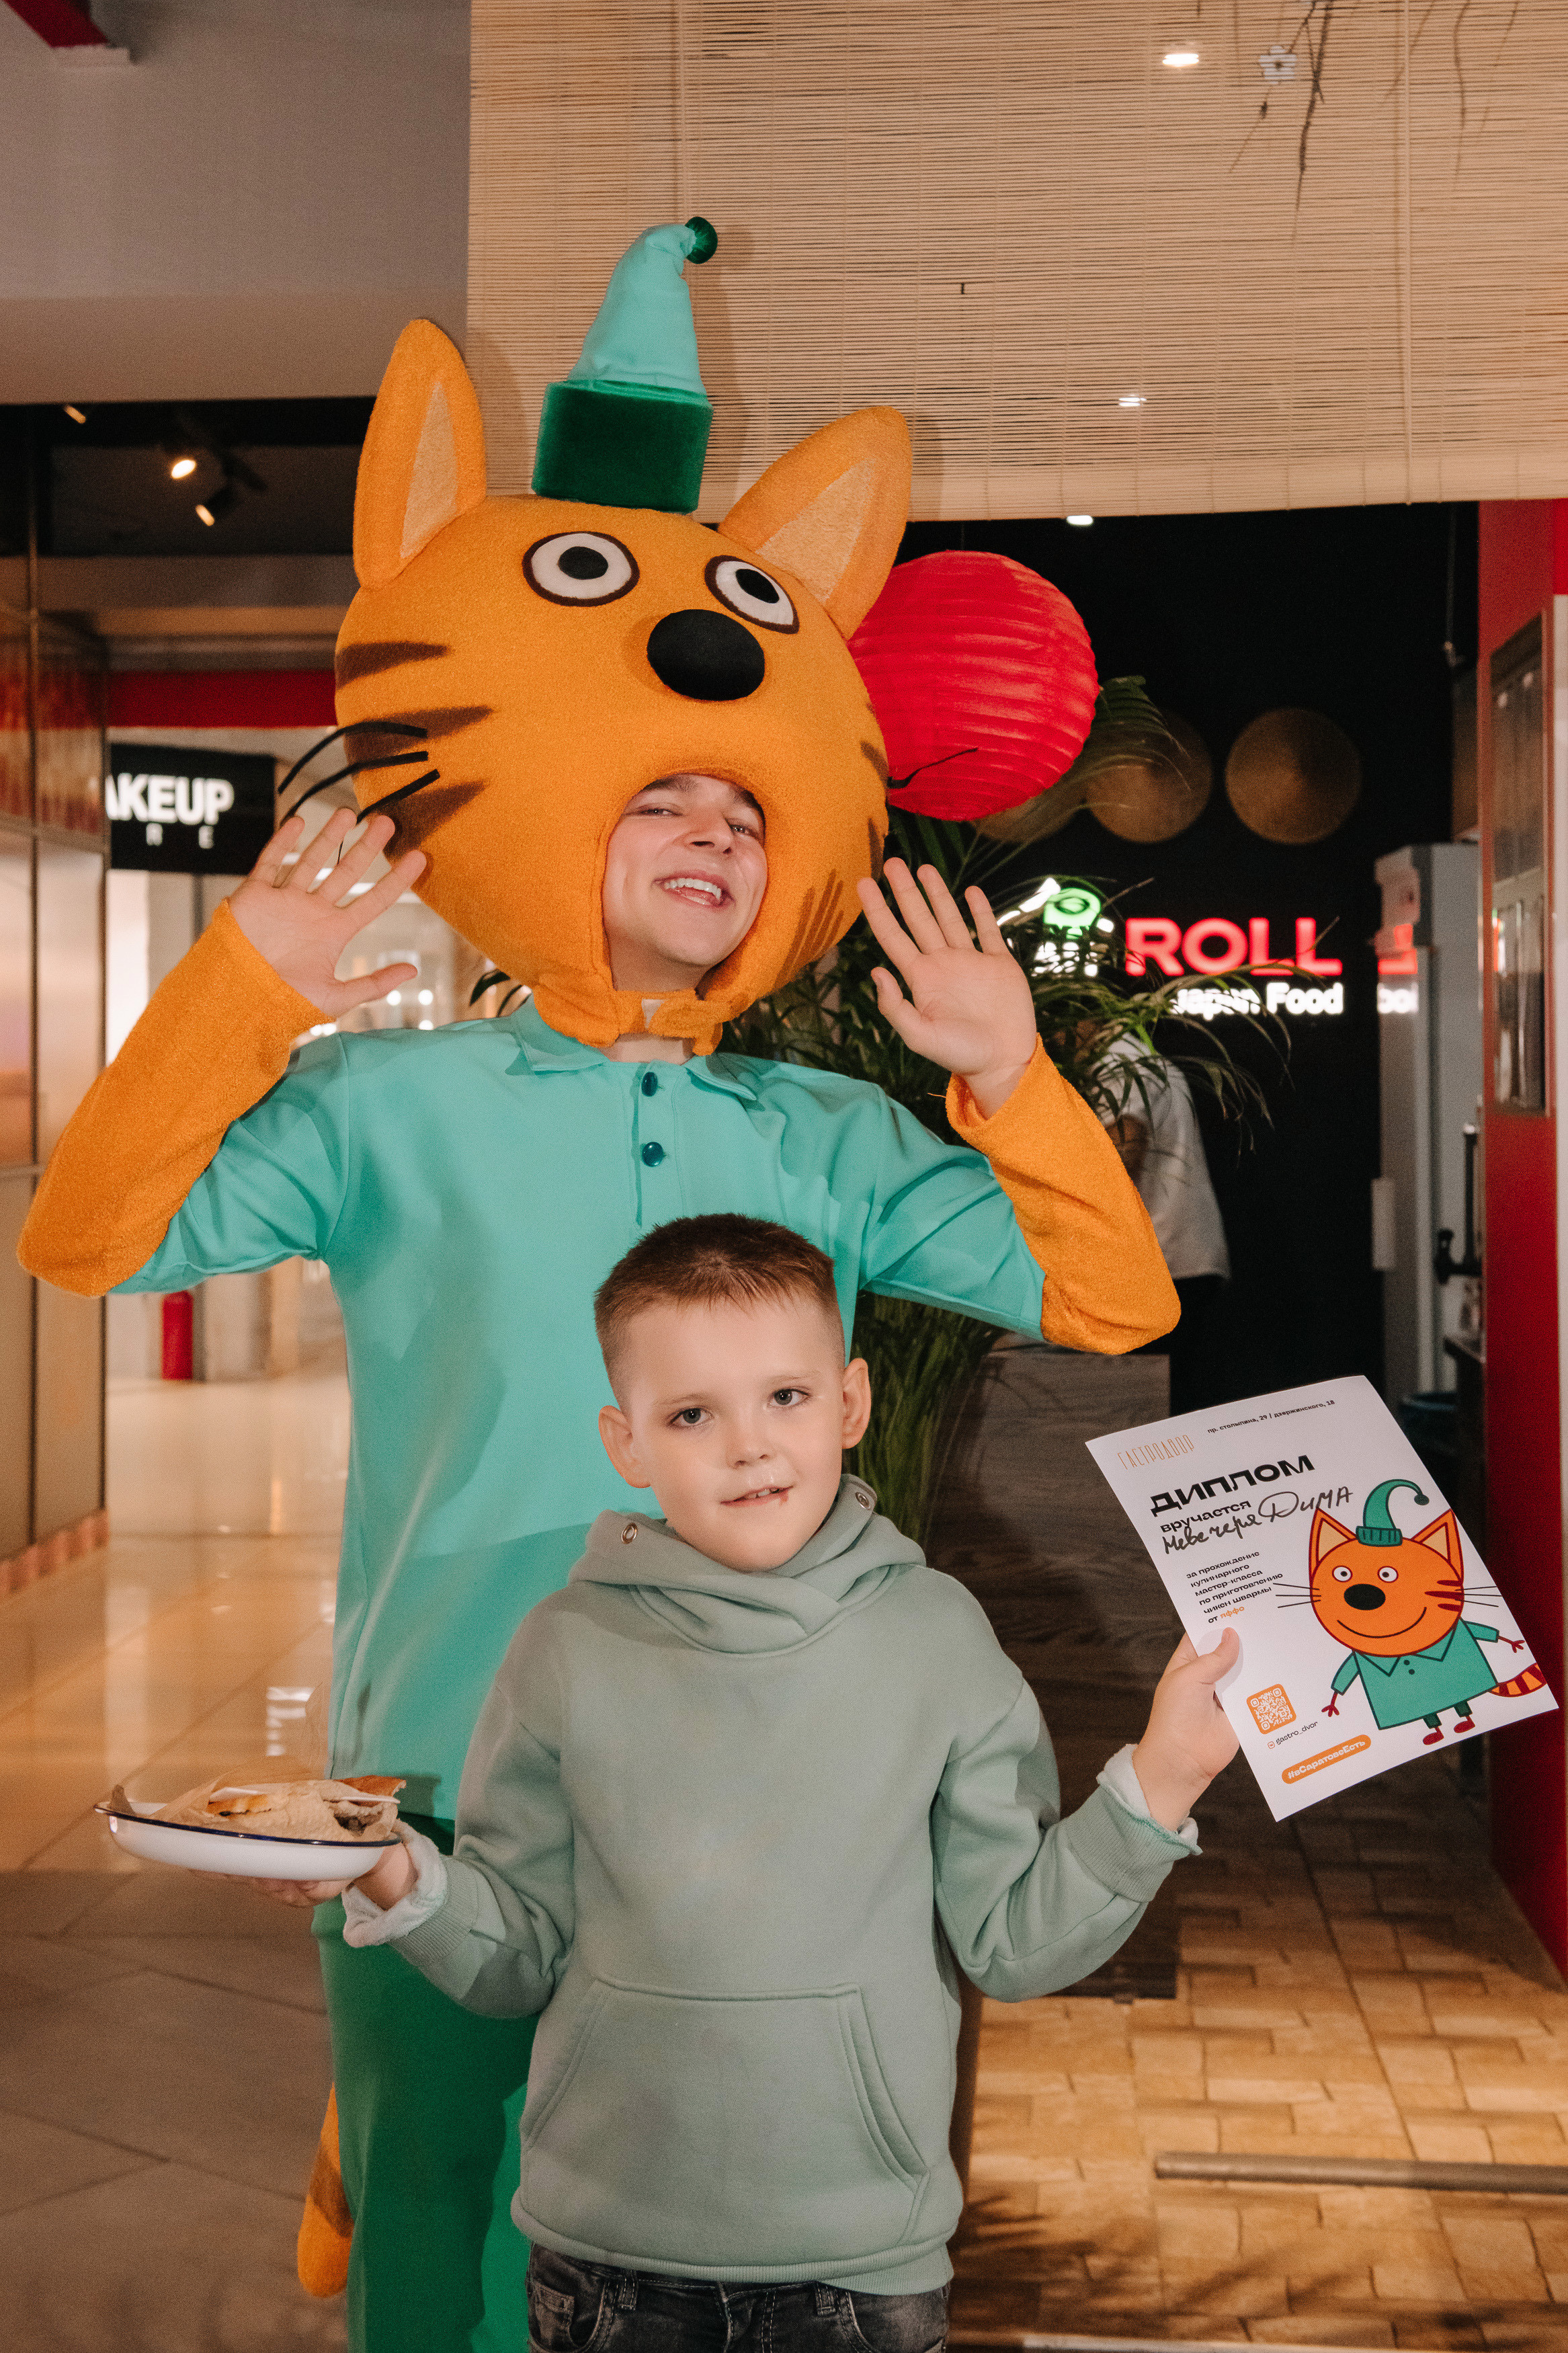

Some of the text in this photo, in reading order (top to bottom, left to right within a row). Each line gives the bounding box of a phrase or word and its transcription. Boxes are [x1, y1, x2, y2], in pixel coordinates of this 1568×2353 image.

[1125, 917, 1343, 976] ROLL
[1266, 982, 1344, 1014] Food
[1219, 1418, 1259, 1430] столыпина,
[1274, 1402, 1326, 1418] дзержинского,
[1117, 1435, 1195, 1470] ГАСТРОДВОР
[1150, 1455, 1315, 1517] ДИПЛОМ
[1160, 1501, 1252, 1533] вручается
[1190, 1564, 1250, 1588] кулинарного
[1198, 1552, 1260, 1575] прохождение
[1195, 1570, 1263, 1597] мастер-класса
[1212, 1573, 1283, 1601] приготовлению
[1203, 1587, 1272, 1613] чикен швармы
[1276, 1721, 1318, 1745] gastro_dvor
